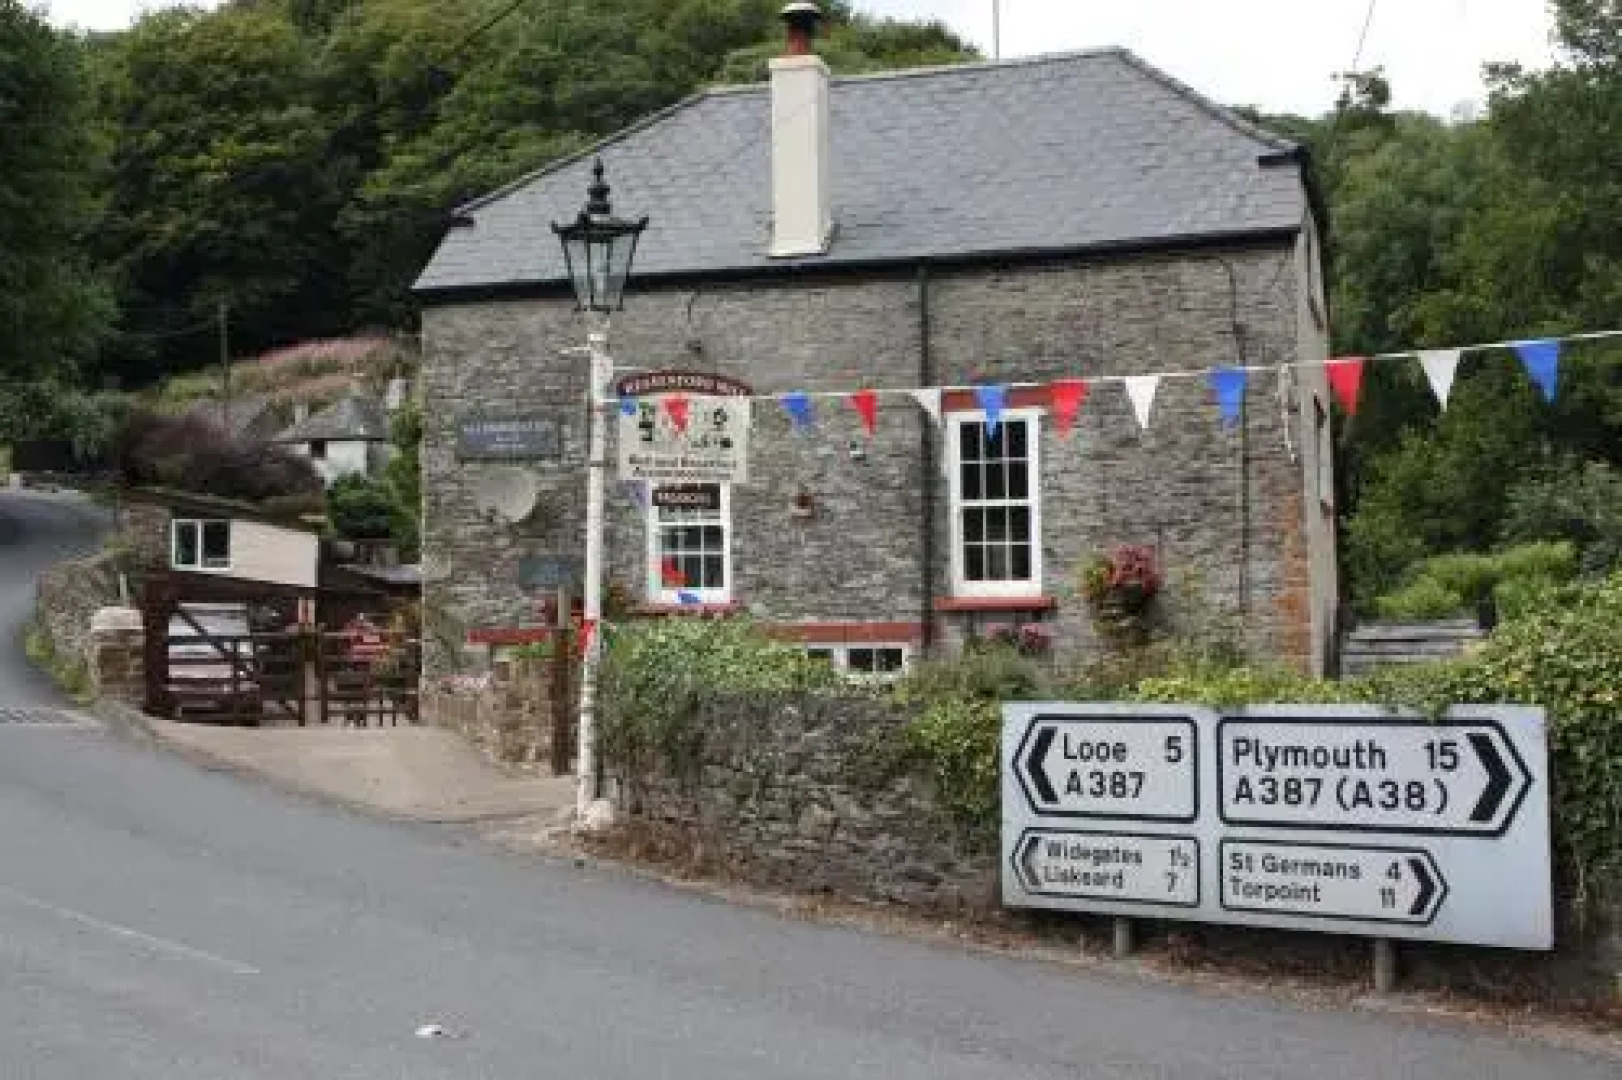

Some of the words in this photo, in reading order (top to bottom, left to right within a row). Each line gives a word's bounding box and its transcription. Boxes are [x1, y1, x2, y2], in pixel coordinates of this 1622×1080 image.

[1064, 733, 1127, 762] Looe
[1165, 735, 1182, 763] 5
[1232, 738, 1386, 772] Plymouth
[1424, 741, 1459, 773] 15
[1064, 769, 1145, 799] A387
[1232, 776, 1324, 805] A387
[1336, 777, 1449, 815] (A38)
[1044, 866, 1124, 889] Liskeard
[1167, 872, 1179, 892] 7
[1229, 852, 1253, 873] St
[1261, 855, 1361, 880] Germans
[1385, 861, 1401, 881] 4
[1230, 875, 1321, 903] Torpoint
